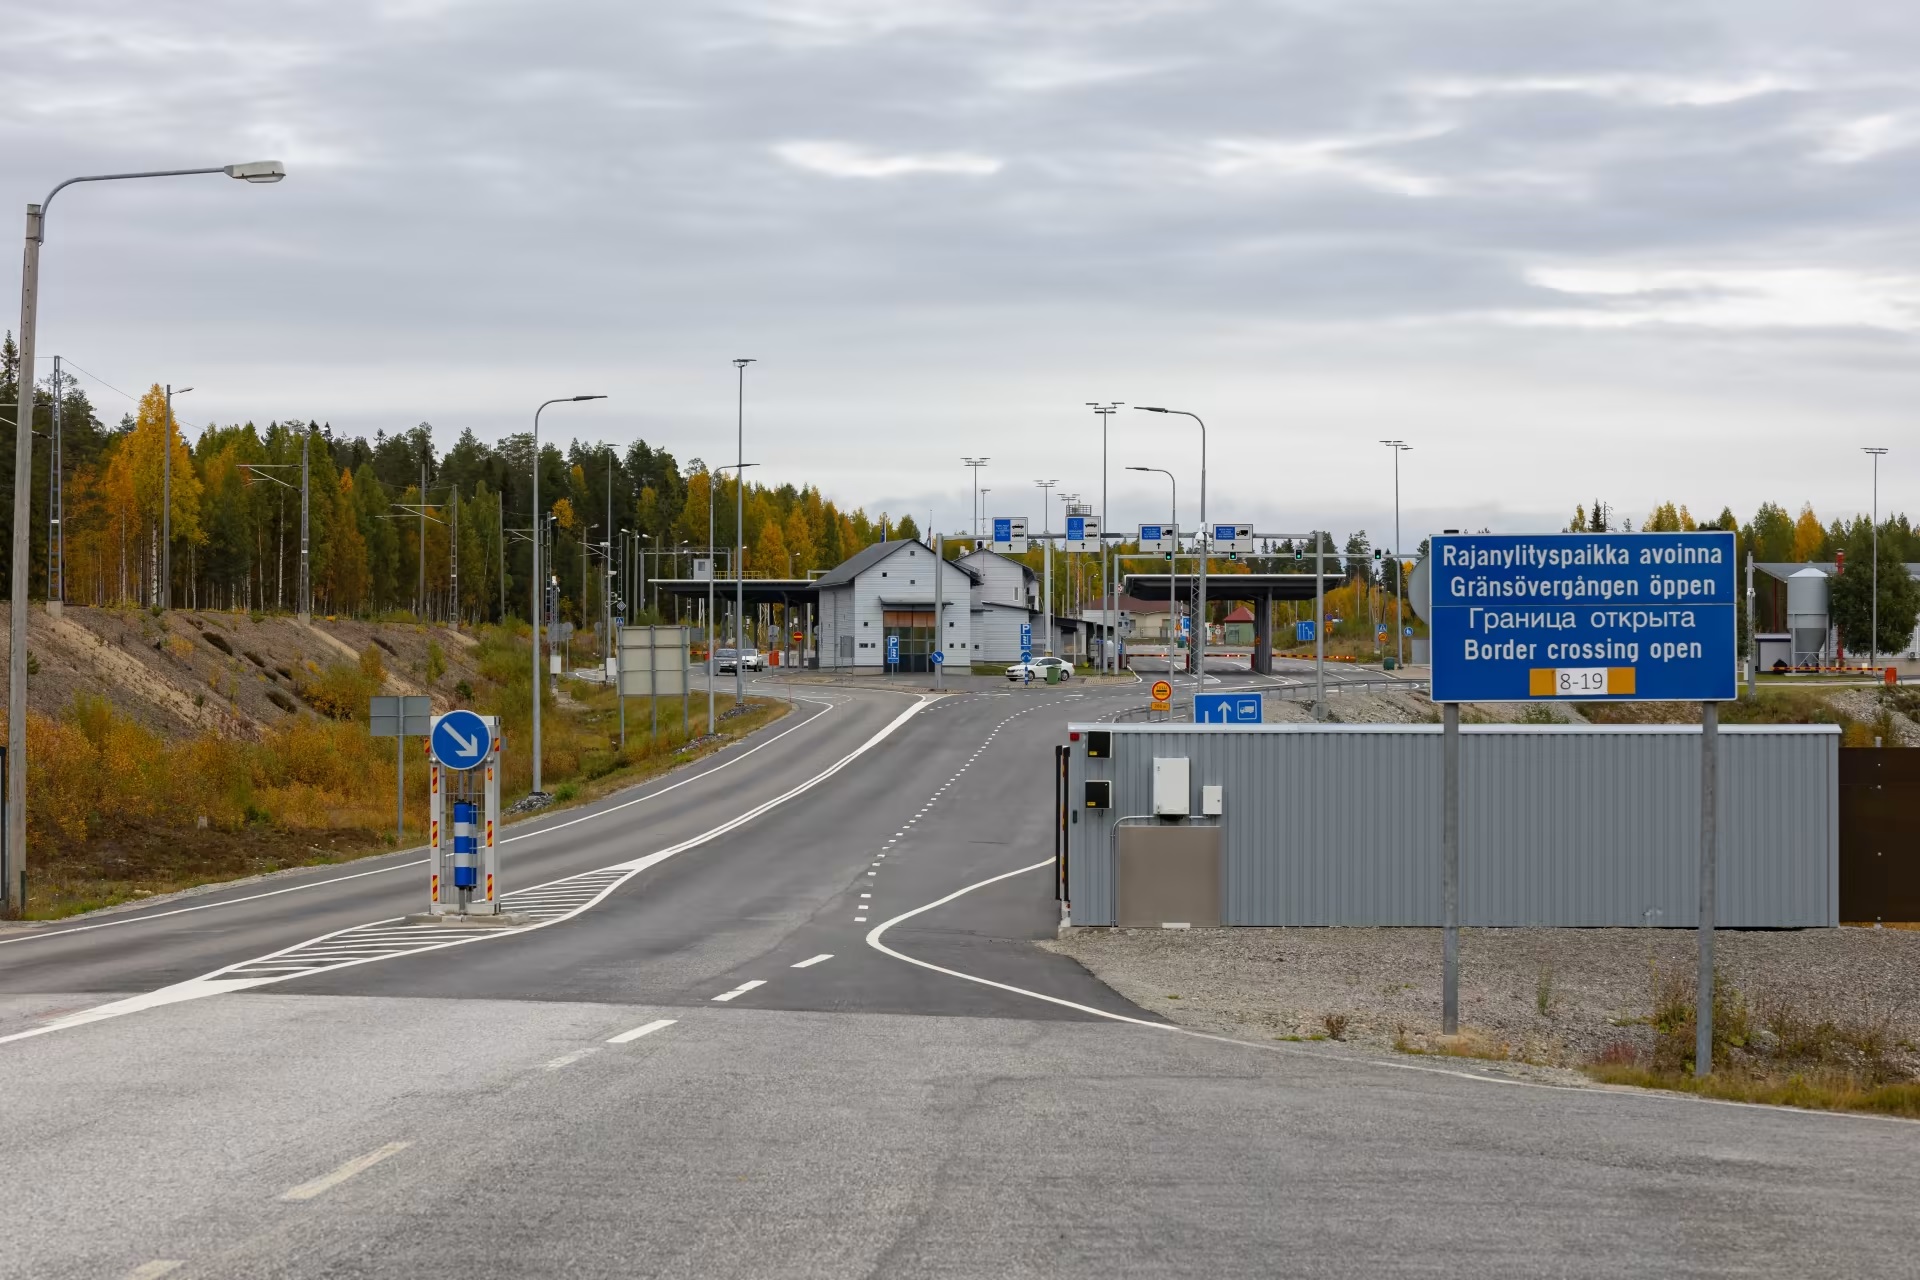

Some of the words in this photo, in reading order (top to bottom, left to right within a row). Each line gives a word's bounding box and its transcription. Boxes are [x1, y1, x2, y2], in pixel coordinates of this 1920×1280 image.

[1443, 544, 1630, 569] Rajanylityspaikka
[1639, 543, 1722, 564] avoinna
[1450, 575, 1639, 600] Gränsövergången
[1650, 574, 1716, 600] öppen
[1022, 624, 1030, 633] P
[1469, 608, 1577, 633] Граница
[1590, 610, 1696, 633] открыта
[889, 637, 897, 646] P
[1464, 638, 1537, 660] Border
[1547, 637, 1639, 663] crossing
[1650, 642, 1702, 663] open
[1559, 672, 1603, 691] 8-19
